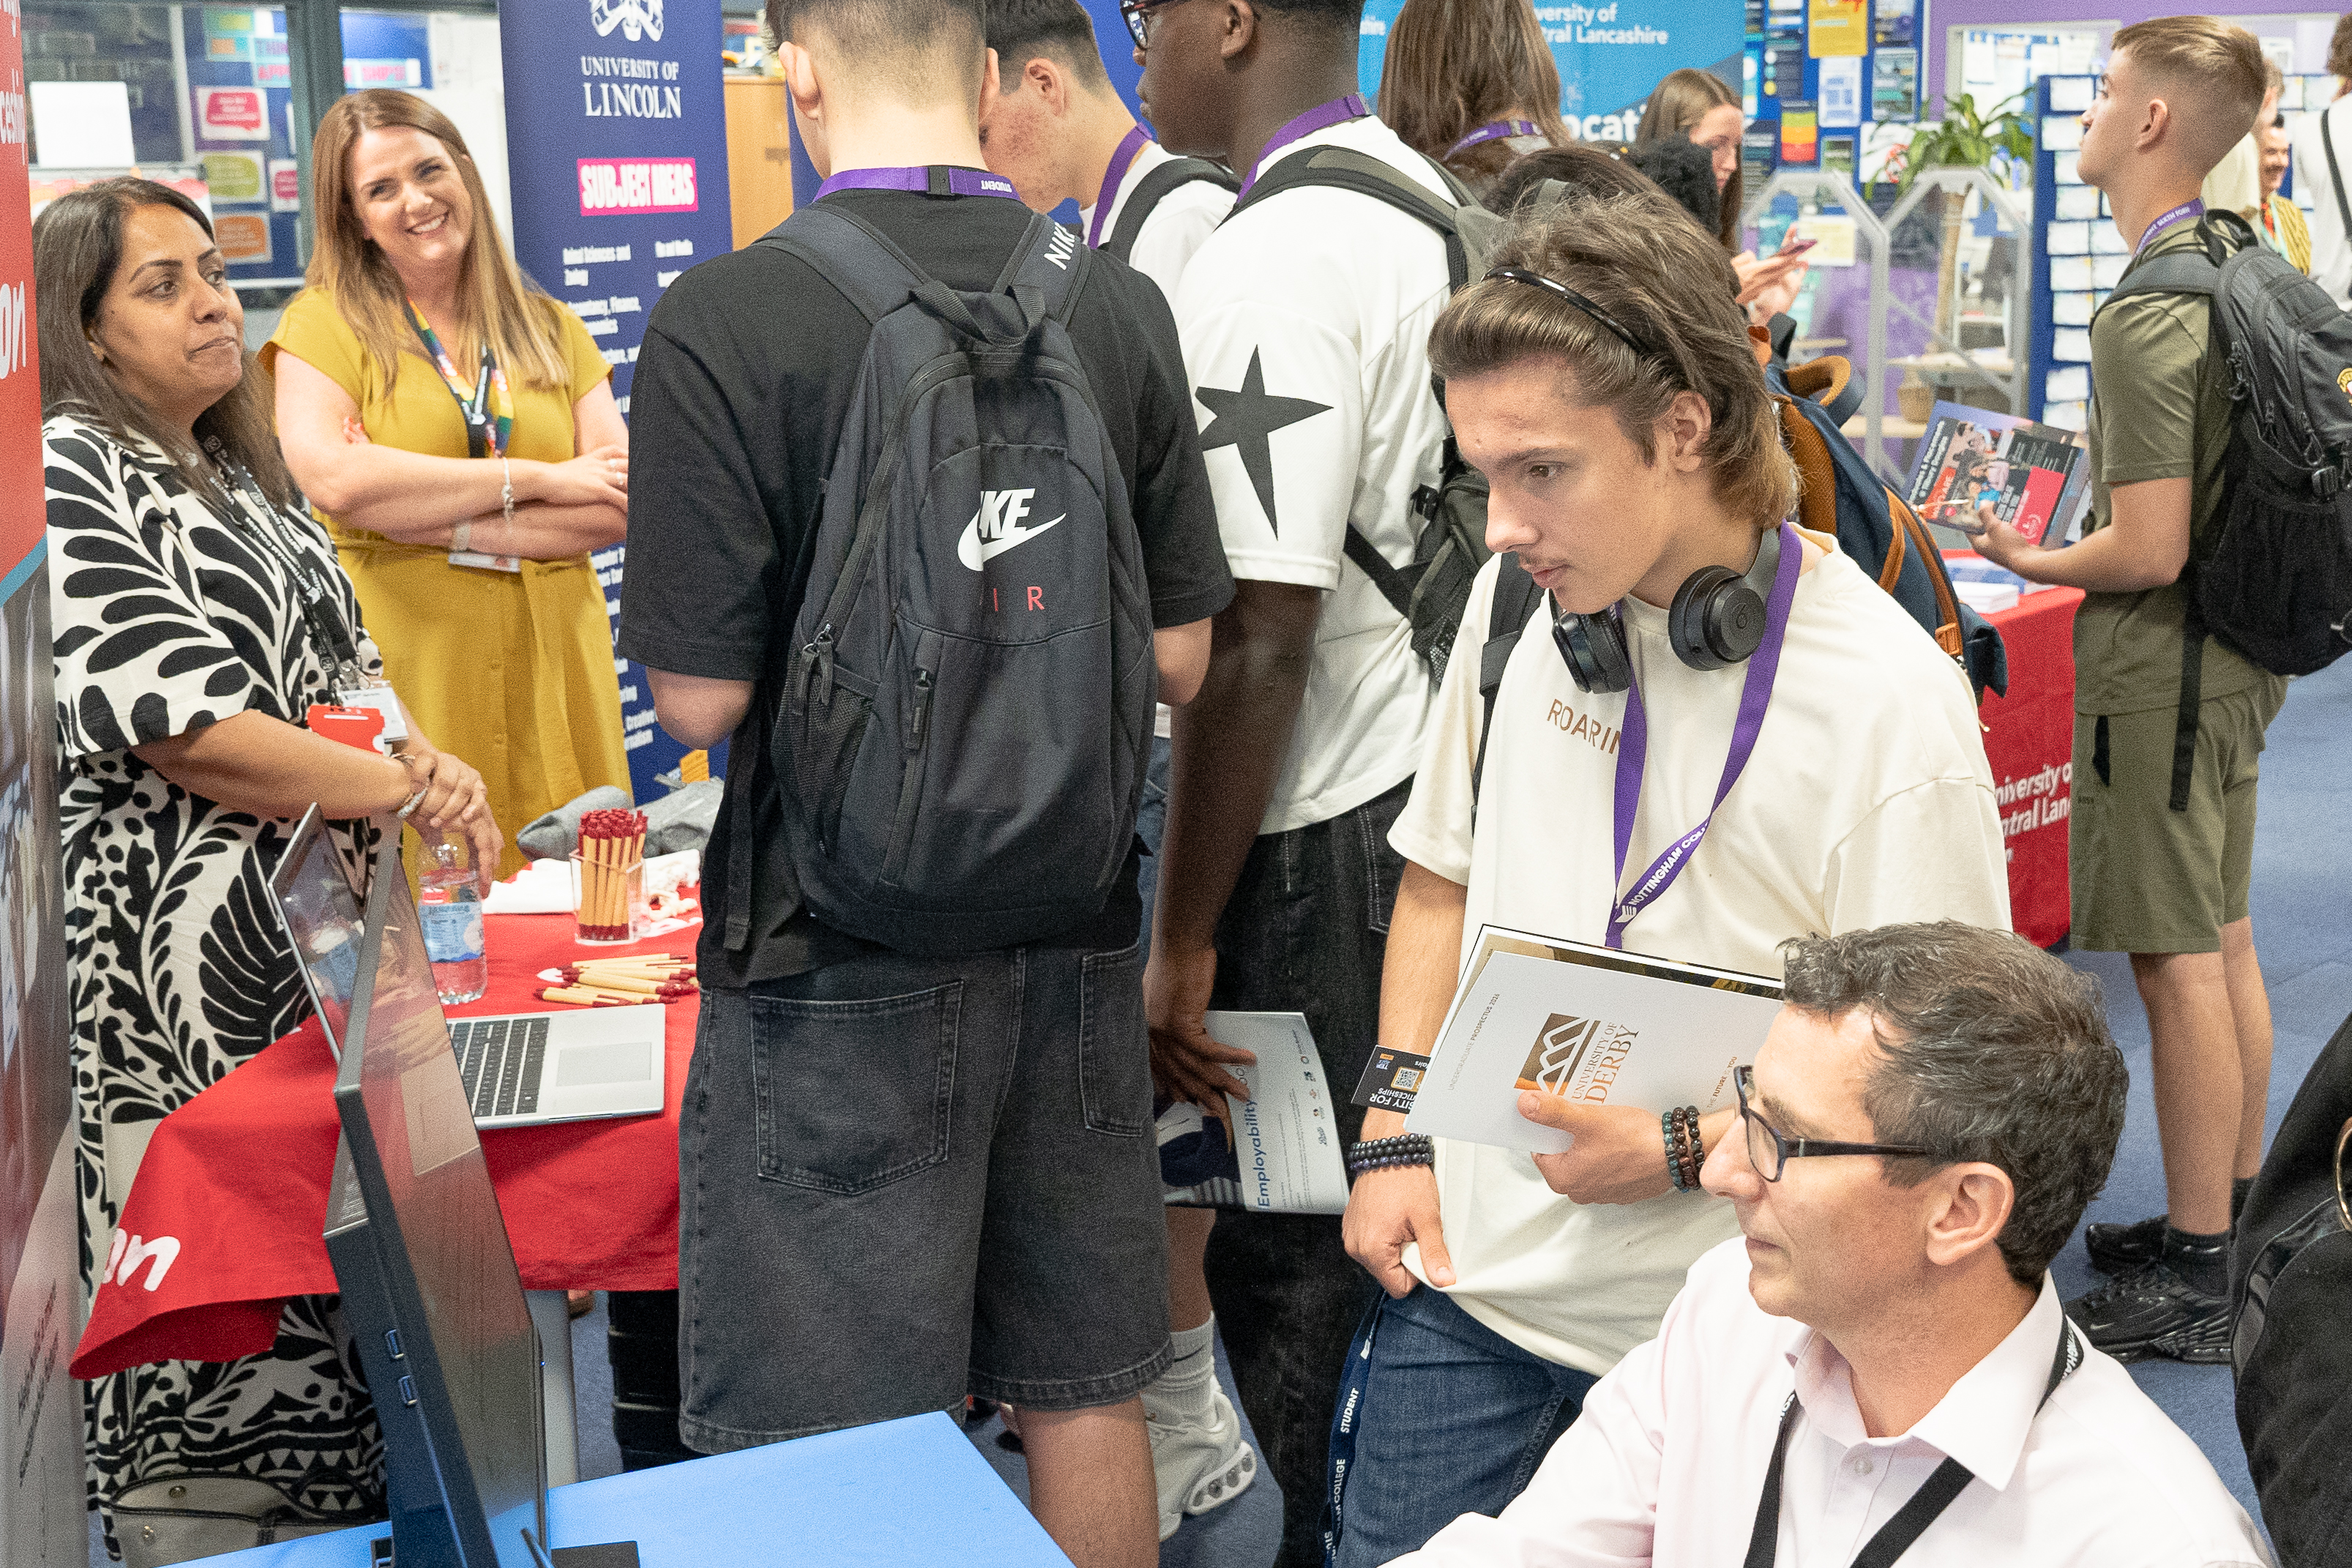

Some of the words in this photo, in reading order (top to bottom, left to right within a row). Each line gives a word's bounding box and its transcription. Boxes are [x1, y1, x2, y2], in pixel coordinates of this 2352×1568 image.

[1534, 3, 1595, 27] versity
[1597, 2, 1617, 23] of
[1541, 23, 1572, 44] tral
[1576, 24, 1669, 45] Lancashire
[581, 56, 659, 79] UNIVERSITY
[662, 61, 679, 81] OF
[583, 82, 682, 119] LINCOLN
[581, 165, 651, 209] SUBJECT
[981, 180, 1012, 193] STUDENT
[1995, 764, 2061, 806] niversity
[2001, 796, 2039, 837] ntral
[1628, 846, 1683, 906] NOTTINGHAM
[1470, 1006, 1493, 1041] PROSPECTUS
[1489, 993, 1500, 1007] 2026
[1571, 1037, 1609, 1100] UNIVERSITY
[1604, 1022, 1617, 1035] OF
[1583, 1024, 1640, 1104] DERBY
[1713, 1075, 1728, 1097] FUTURE
[1727, 1056, 1738, 1069] YOU
[1369, 1093, 1392, 1105] FOR
[1244, 1099, 1270, 1208] Employability
[1340, 1387, 1359, 1434] STUDENT
[1334, 1458, 1345, 1504] COLLEGE
